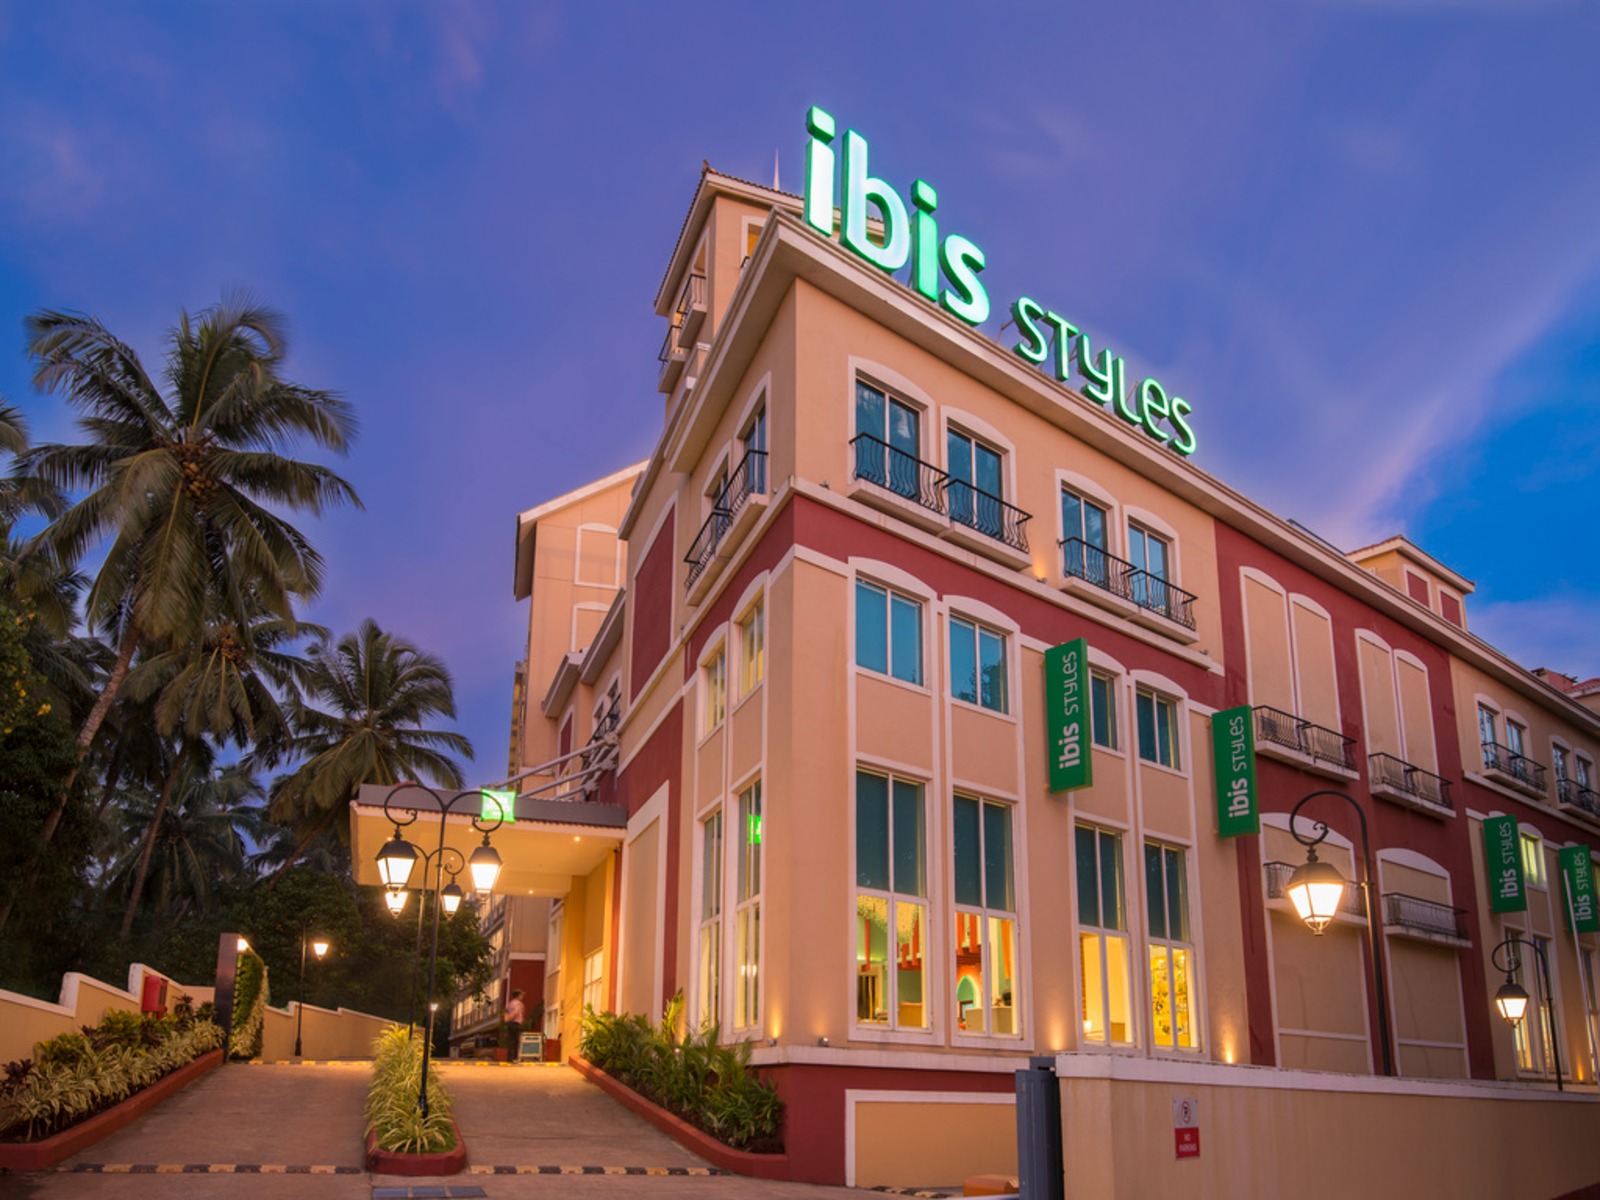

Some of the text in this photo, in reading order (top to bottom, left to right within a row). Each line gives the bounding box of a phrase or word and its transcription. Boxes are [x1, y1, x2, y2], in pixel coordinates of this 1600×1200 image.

[804, 105, 990, 327] ibis
[1058, 722, 1080, 769] ibis
[1227, 777, 1249, 818] ibis
[1499, 868, 1519, 898] ibis
[1573, 894, 1592, 921] ibis
